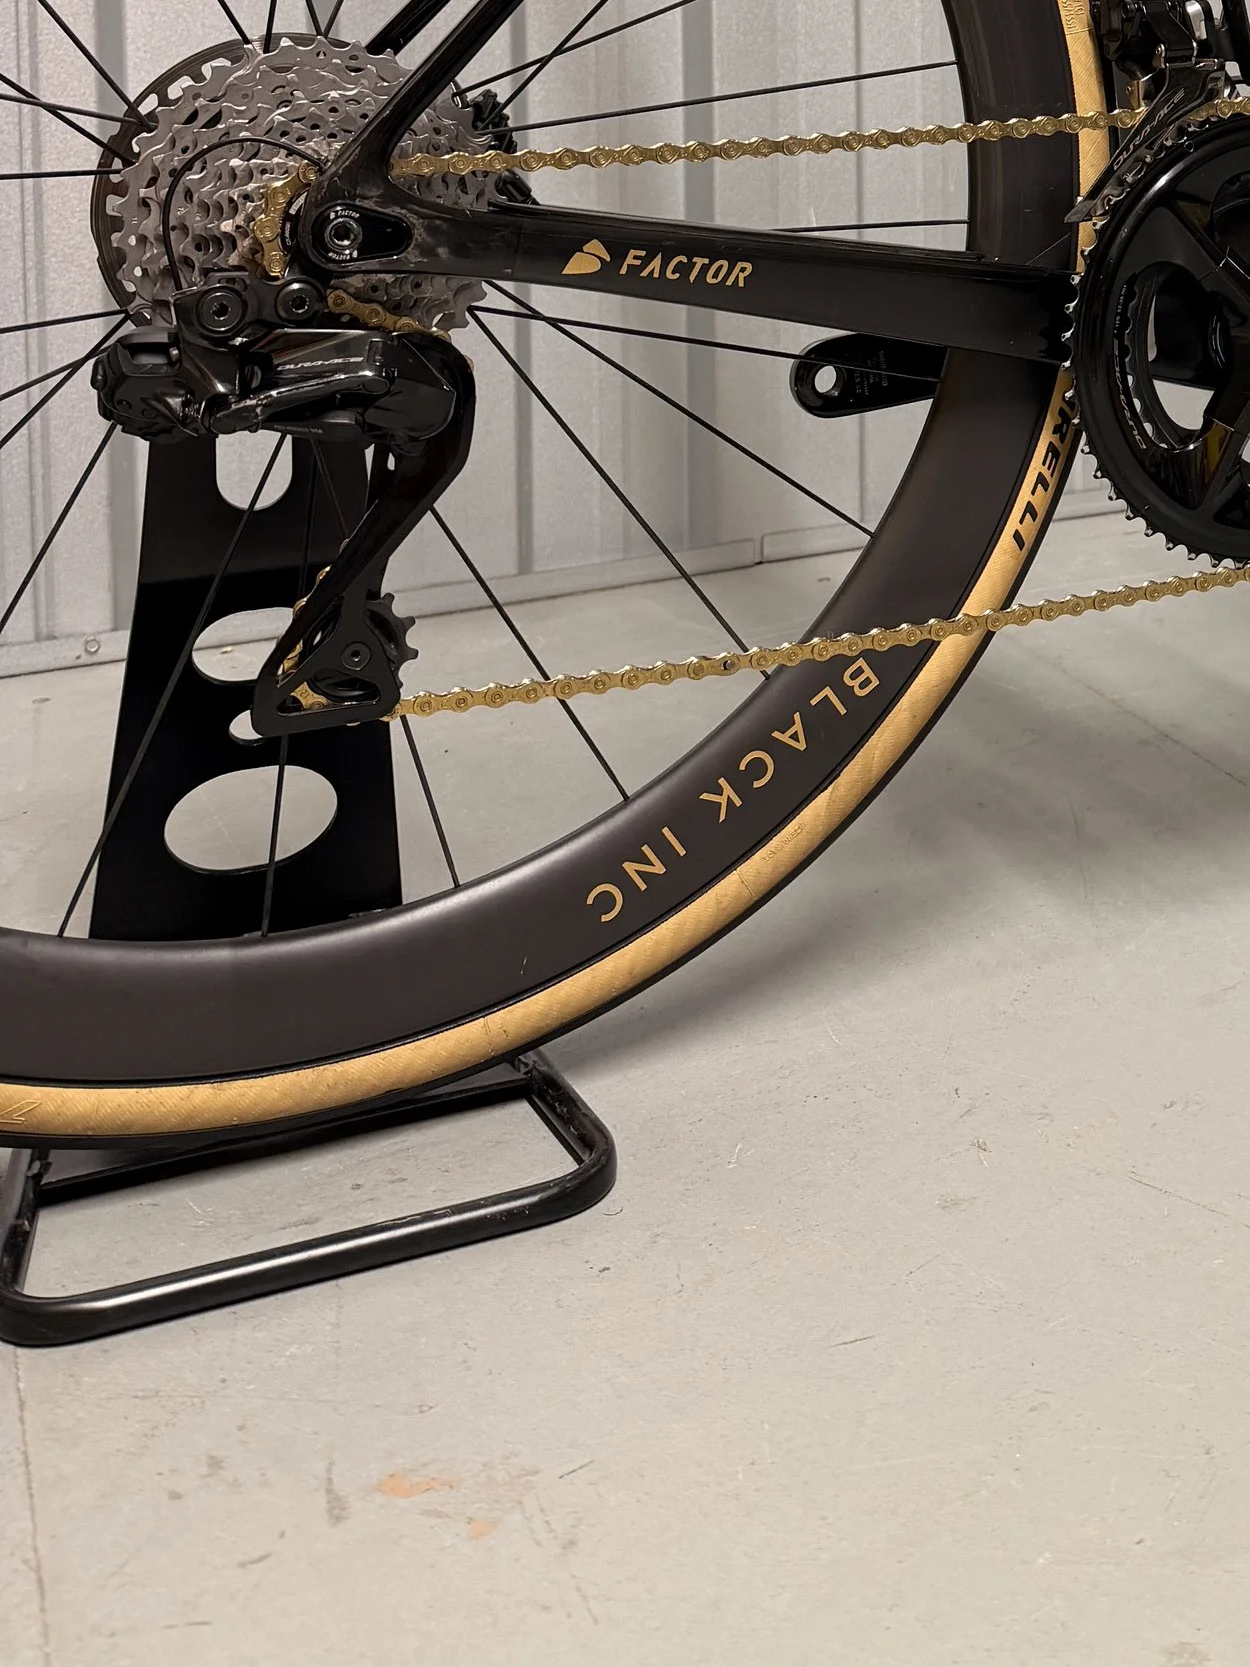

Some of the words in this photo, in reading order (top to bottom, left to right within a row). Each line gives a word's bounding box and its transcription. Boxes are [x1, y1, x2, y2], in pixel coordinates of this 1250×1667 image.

[1113, 87, 1185, 171] DURA-ACE
[617, 248, 754, 290] FACTOR
[699, 657, 880, 823] BLACK
[585, 825, 688, 924] INC
